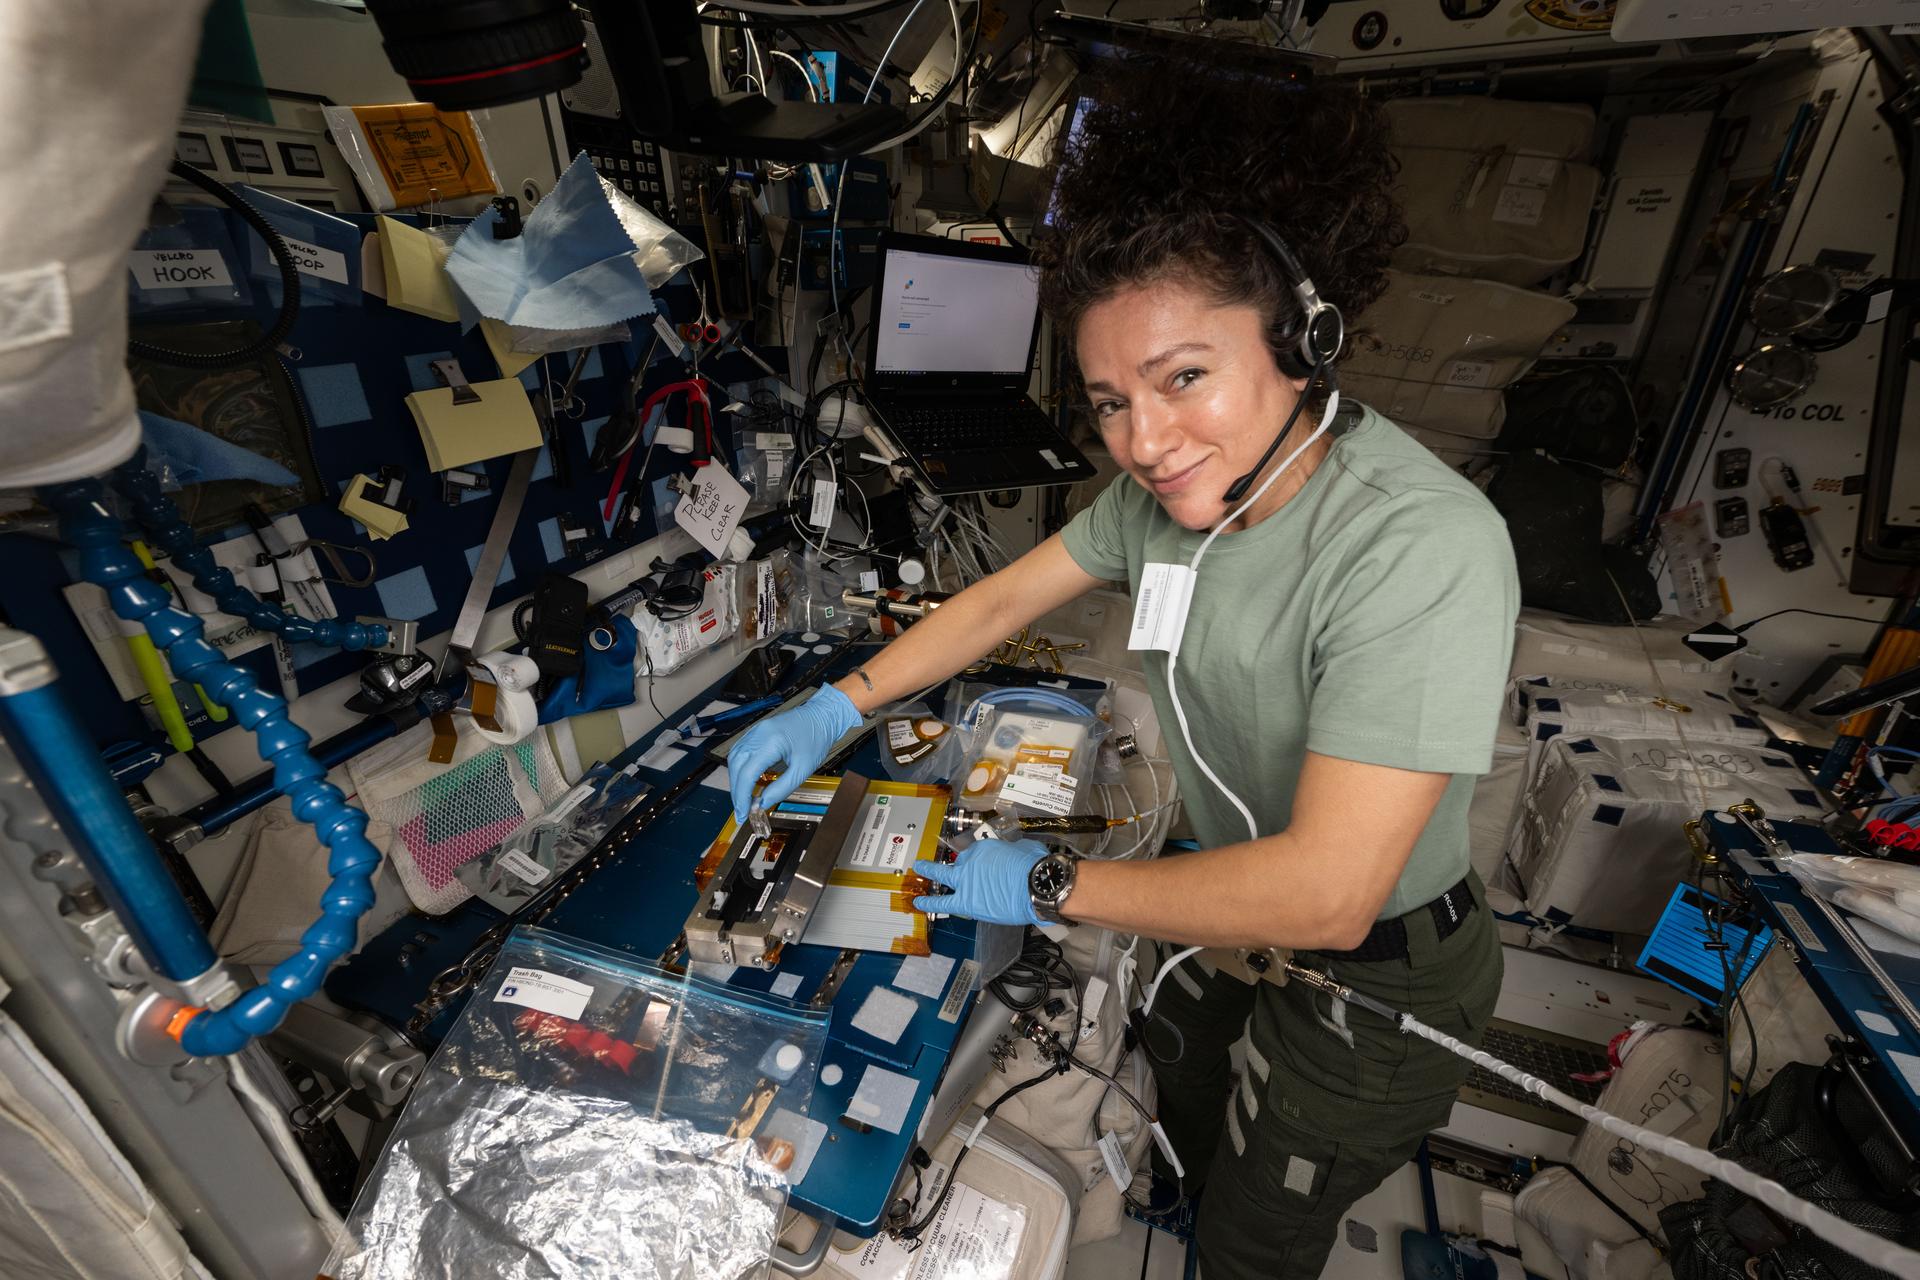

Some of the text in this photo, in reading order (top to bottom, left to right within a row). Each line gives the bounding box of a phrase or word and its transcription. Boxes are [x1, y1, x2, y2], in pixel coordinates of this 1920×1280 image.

[153, 252, 194, 262] VELCRO
[288, 242, 318, 256] VELCRO
[291, 254, 326, 271] OOP
[153, 265, 216, 283] HOOK
[1366, 343, 1434, 363] 0-5068
[1773, 403, 1845, 421] To COL
[682, 481, 717, 522] PLEASE
[701, 493, 720, 521] KEEP
[710, 503, 736, 542] CLEAR
[184, 714, 207, 727] CHED
[1031, 799, 1068, 814] Nano Cuvette
[1442, 892, 1457, 922] RCADE
[916, 1255, 929, 1279] DLESS
[925, 1221, 942, 1255] VACUUM
[938, 1184, 956, 1220] CLEANER
[951, 1231, 960, 1247] Pack
[860, 1236, 877, 1265] CORDLE
[871, 1230, 887, 1257] ACCES
